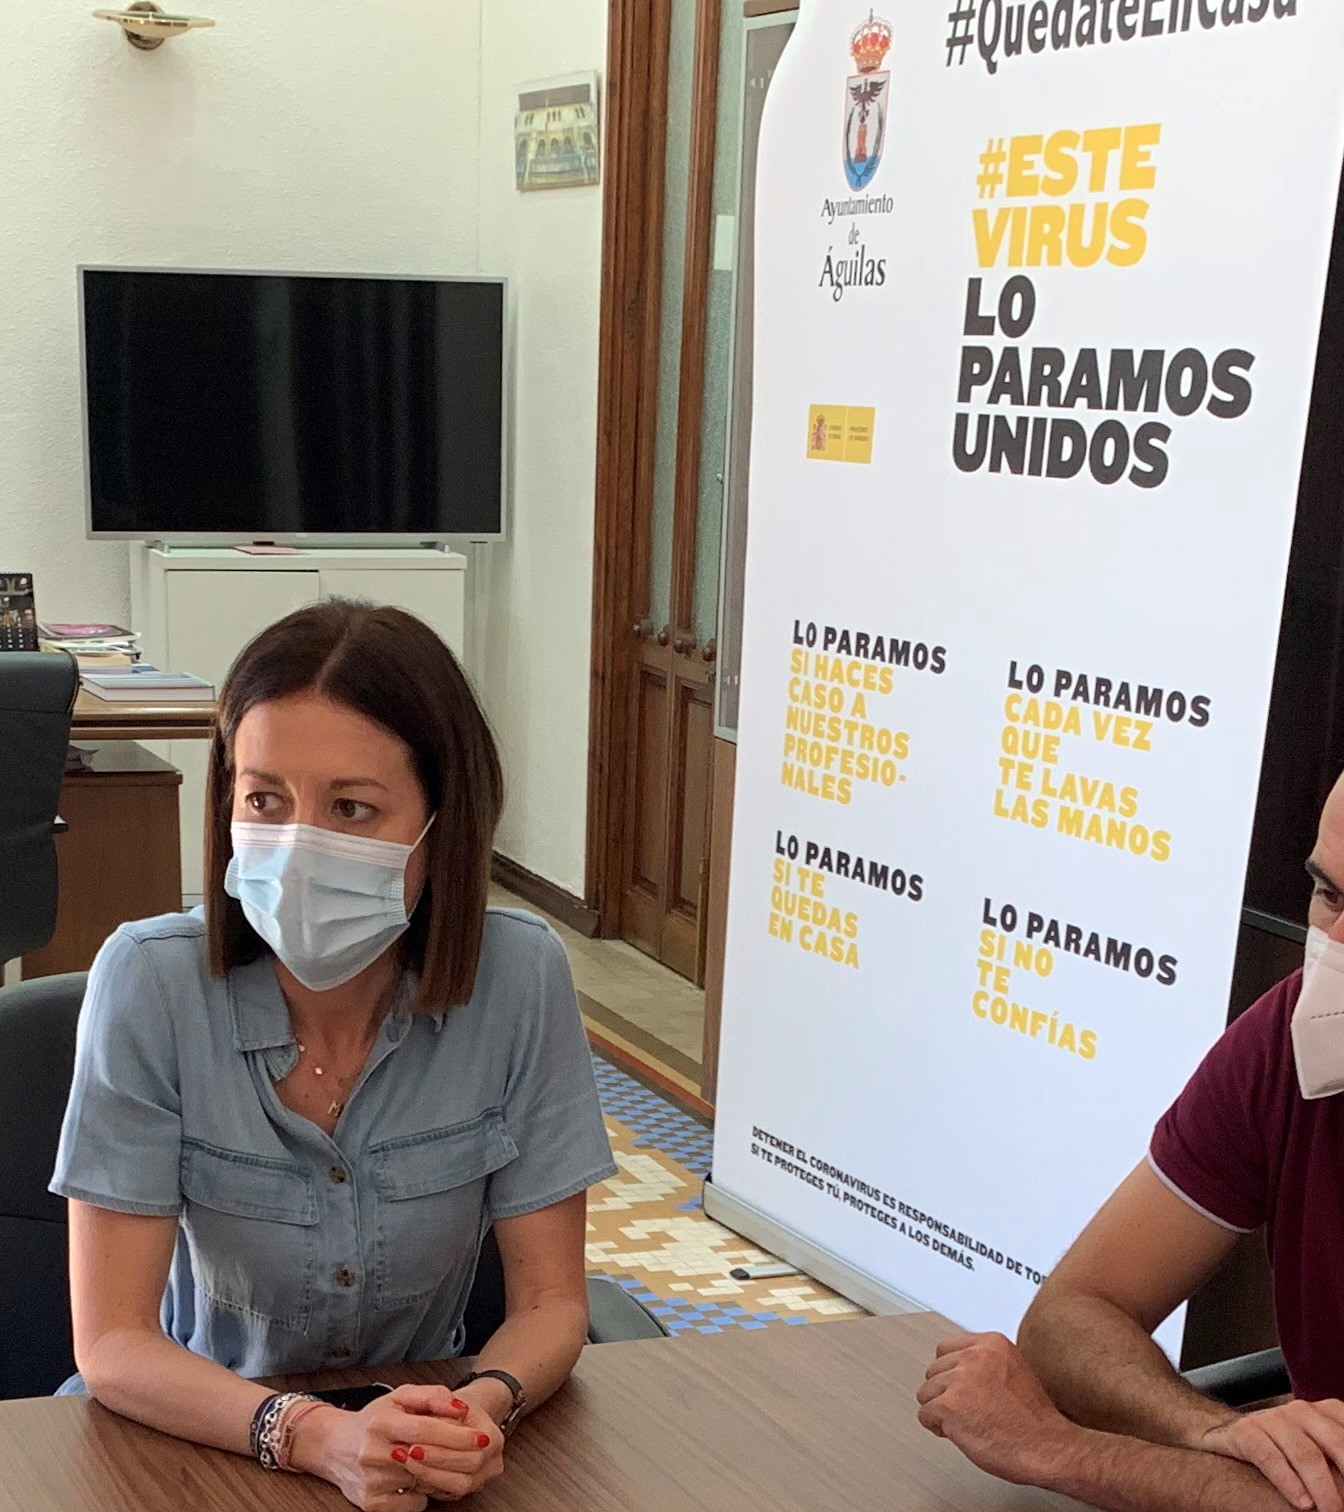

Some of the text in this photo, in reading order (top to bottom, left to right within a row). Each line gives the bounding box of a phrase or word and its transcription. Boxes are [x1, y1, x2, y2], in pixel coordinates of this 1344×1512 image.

[976, 123, 1161, 198] #ESTE
[821, 194, 893, 219] Ayuntamiento
[848, 223, 860, 245] de
[971, 198, 1150, 268] VIRUS
[818, 245, 886, 302] Águilas
[963, 275, 1036, 337] LO
[956, 346, 1256, 419] PARAMOS
[952, 413, 1173, 488] UNIDOS
[790, 648, 894, 695] SI HACES
[793, 619, 947, 674] LO PARAMOS
[787, 677, 867, 719] CASO A
[1003, 693, 1154, 752] CADA VEZ
[1008, 661, 1212, 727] LO PARAMOS
[783, 734, 907, 787] PROFESIO-
[785, 706, 910, 760] NUESTROS
[1001, 726, 1060, 765] QUE
[781, 762, 852, 805] NALES
[999, 758, 1138, 818] TE LAVAS
[994, 789, 1173, 862] LAS MANOS
[773, 858, 825, 899] SI TE
[776, 830, 924, 902] LO PARAMOS
[768, 911, 859, 969] EN CASA
[770, 886, 858, 939] QUEDAS
[982, 897, 1179, 986] LO PARAMOS
[976, 959, 1011, 995] TE
[978, 928, 1054, 978] SI NO
[972, 990, 1098, 1060] CONFÍAS
[751, 1143, 975, 1273] SI TE PROTEGES TÚ, PROTEGES A LOS DEMÁS.
[752, 1125, 795, 1157] DETENER
[796, 1150, 808, 1164] EL
[810, 1156, 881, 1202] CORONAVIRUS
[882, 1192, 896, 1210] ES
[898, 1201, 1003, 1266] RESPONSABILIDAD
[1006, 1256, 1022, 1276] DE
